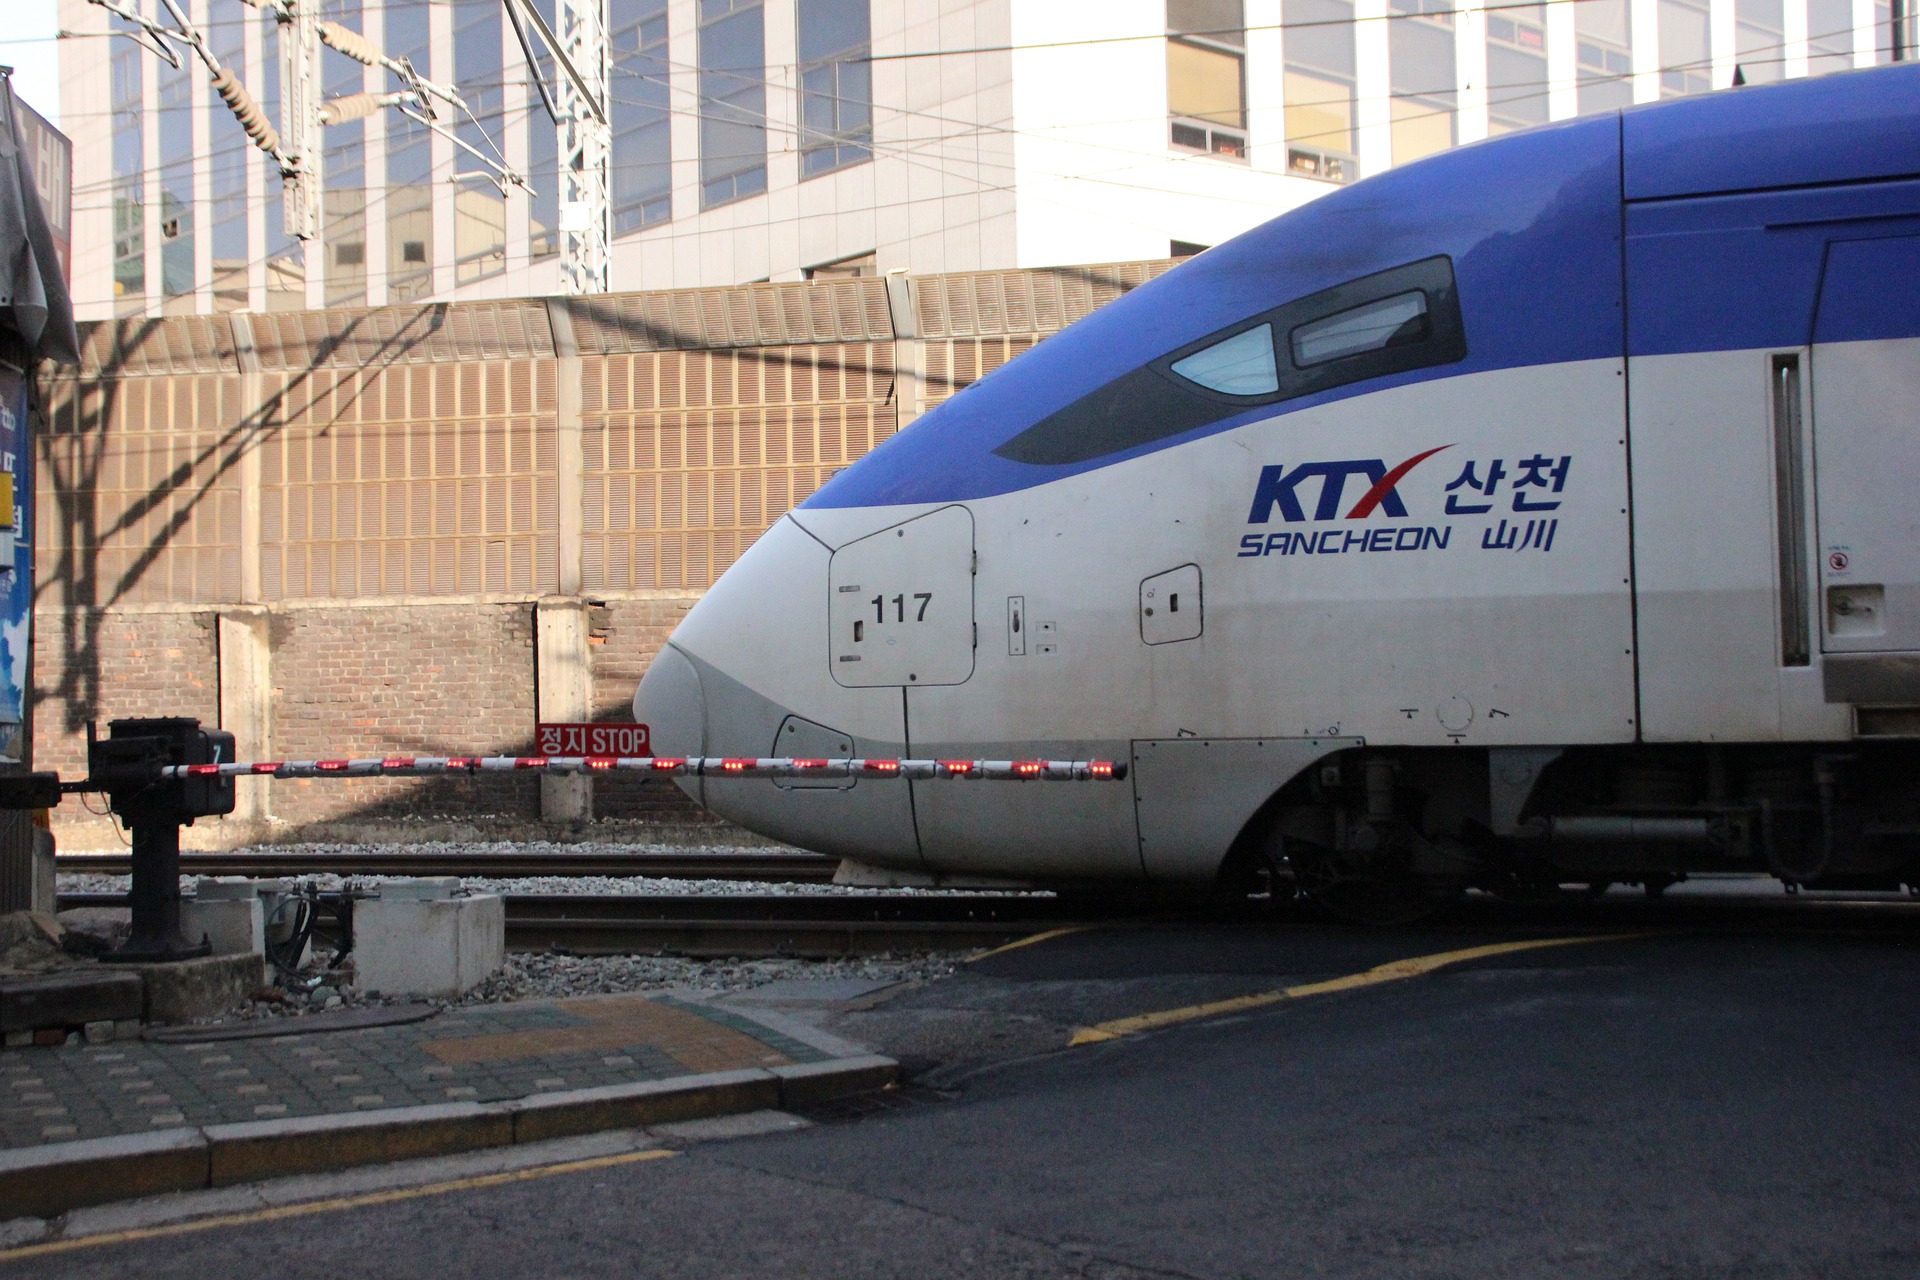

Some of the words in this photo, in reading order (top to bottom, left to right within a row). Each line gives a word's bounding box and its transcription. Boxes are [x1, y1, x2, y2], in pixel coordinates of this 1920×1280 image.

[1248, 443, 1460, 523] KTX
[1444, 454, 1572, 515] 산천
[1237, 526, 1452, 557] SANCHEON
[1481, 519, 1558, 553] 山川
[871, 592, 932, 624] 117
[540, 727, 586, 755] 정지
[592, 728, 646, 754] STOP
